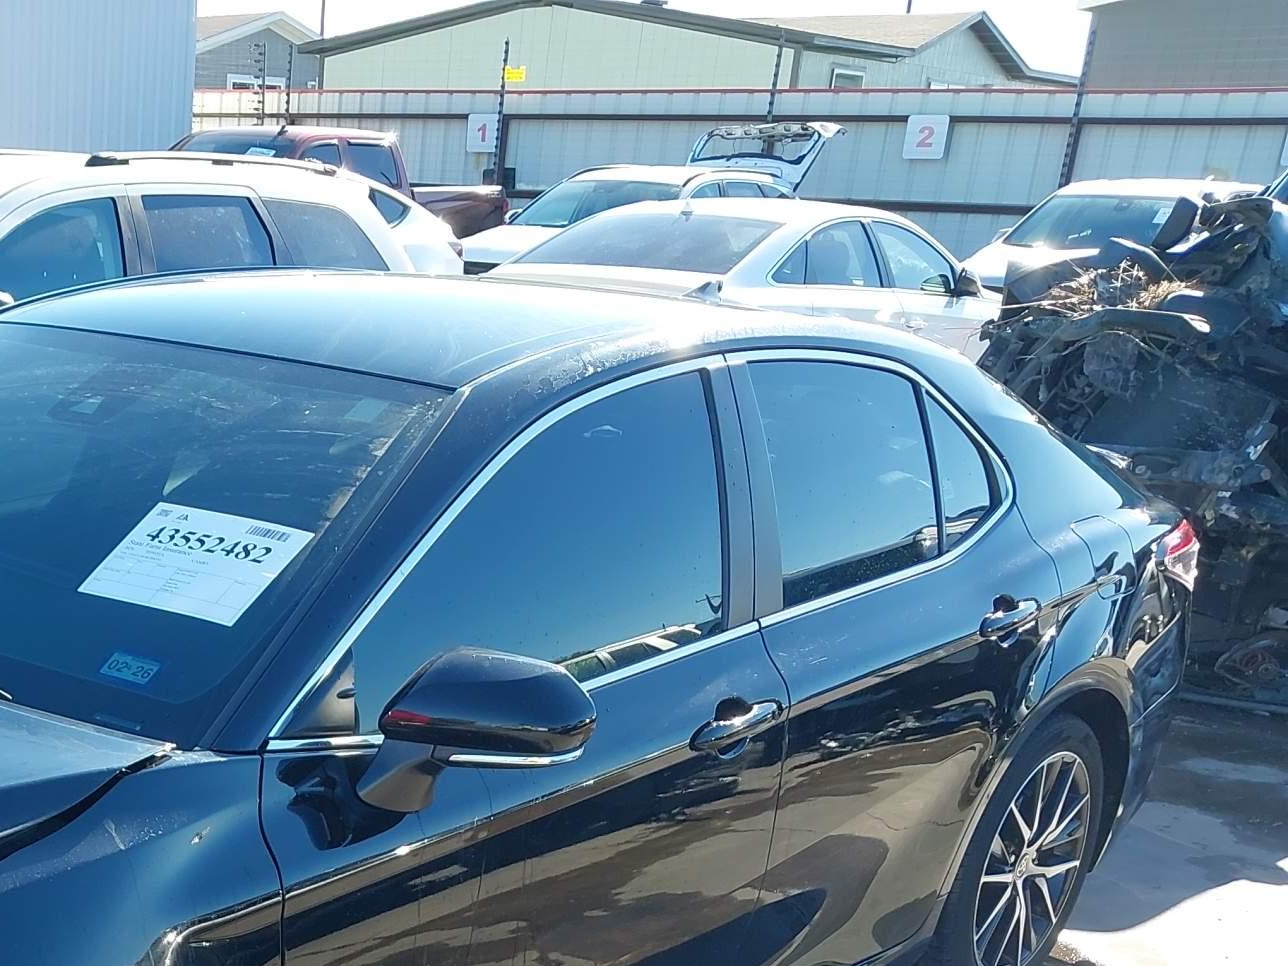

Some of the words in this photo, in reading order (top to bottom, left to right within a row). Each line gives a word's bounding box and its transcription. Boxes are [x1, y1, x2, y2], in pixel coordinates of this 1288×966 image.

[477, 123, 487, 142] 1
[915, 126, 936, 148] 2
[145, 525, 273, 565] 43552482
[107, 659, 129, 673] 02
[130, 665, 154, 679] 26
